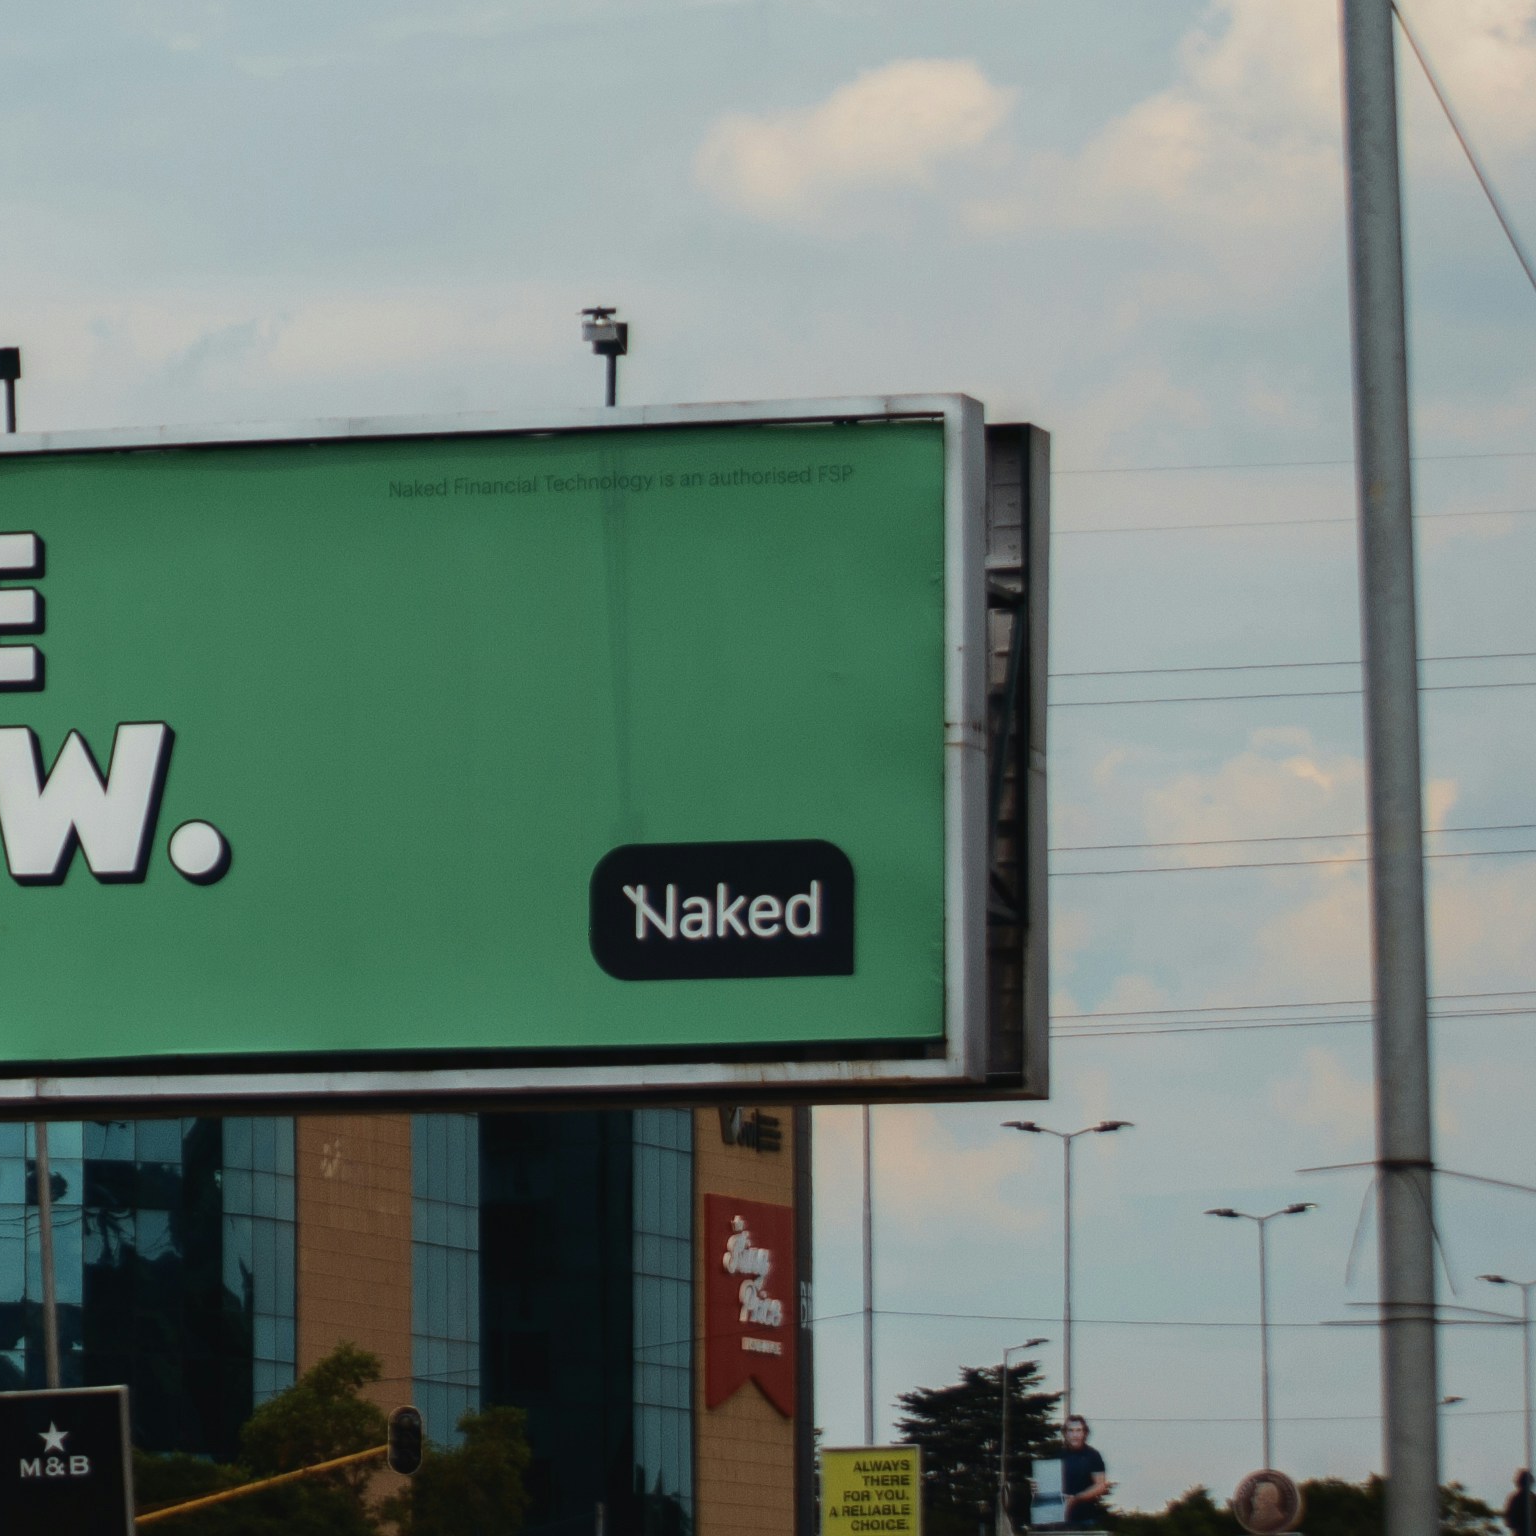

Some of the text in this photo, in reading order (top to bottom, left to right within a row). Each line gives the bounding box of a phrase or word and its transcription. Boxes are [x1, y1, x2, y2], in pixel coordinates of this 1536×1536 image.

[388, 463, 854, 498] Naked Financial Technology is an authorised FSP
[623, 879, 822, 939] Naked
[853, 1459, 910, 1472] ALWAYS
[862, 1474, 910, 1486] THERE
[843, 1489, 909, 1502] FOR YOU.
[829, 1504, 910, 1517] A RELIABLE
[850, 1519, 910, 1531] CHOICE.
